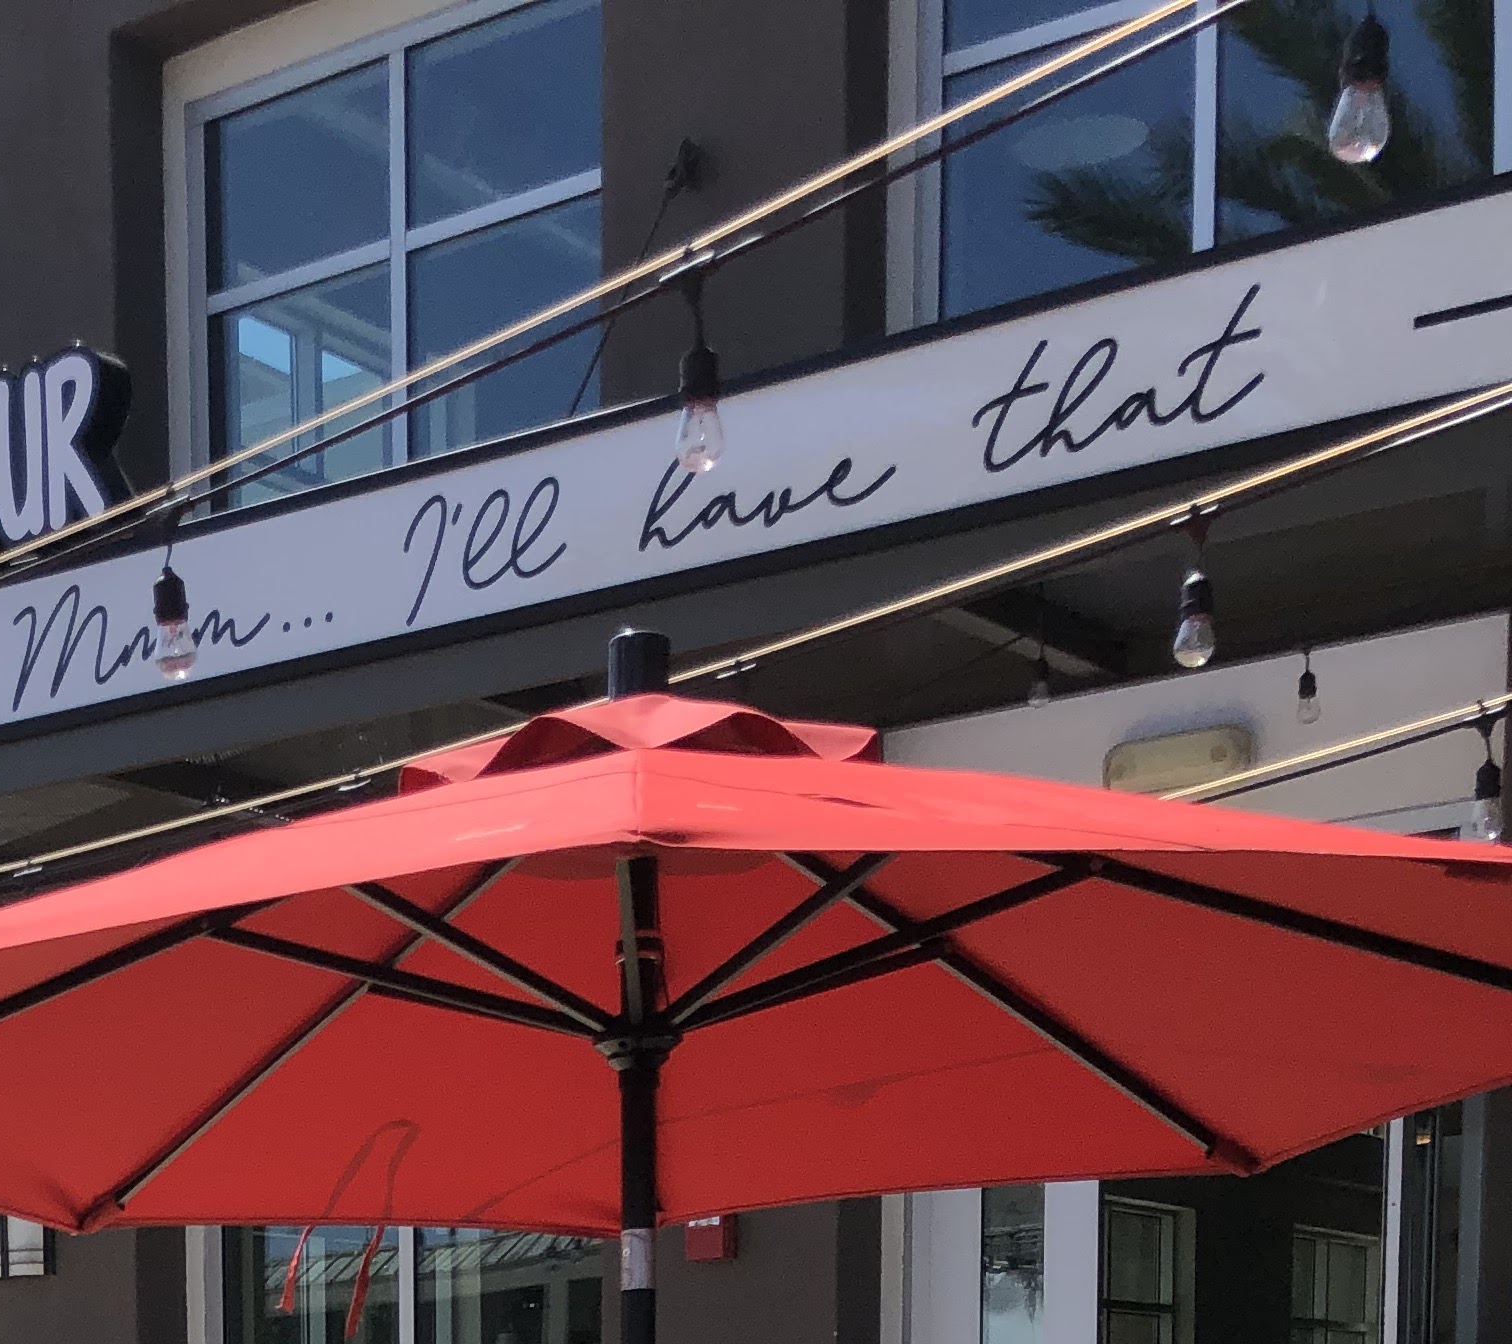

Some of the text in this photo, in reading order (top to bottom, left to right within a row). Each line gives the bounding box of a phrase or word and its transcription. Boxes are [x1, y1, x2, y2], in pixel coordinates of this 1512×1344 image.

[403, 475, 567, 627] I'll
[638, 455, 897, 552] have
[971, 282, 1266, 473] that
